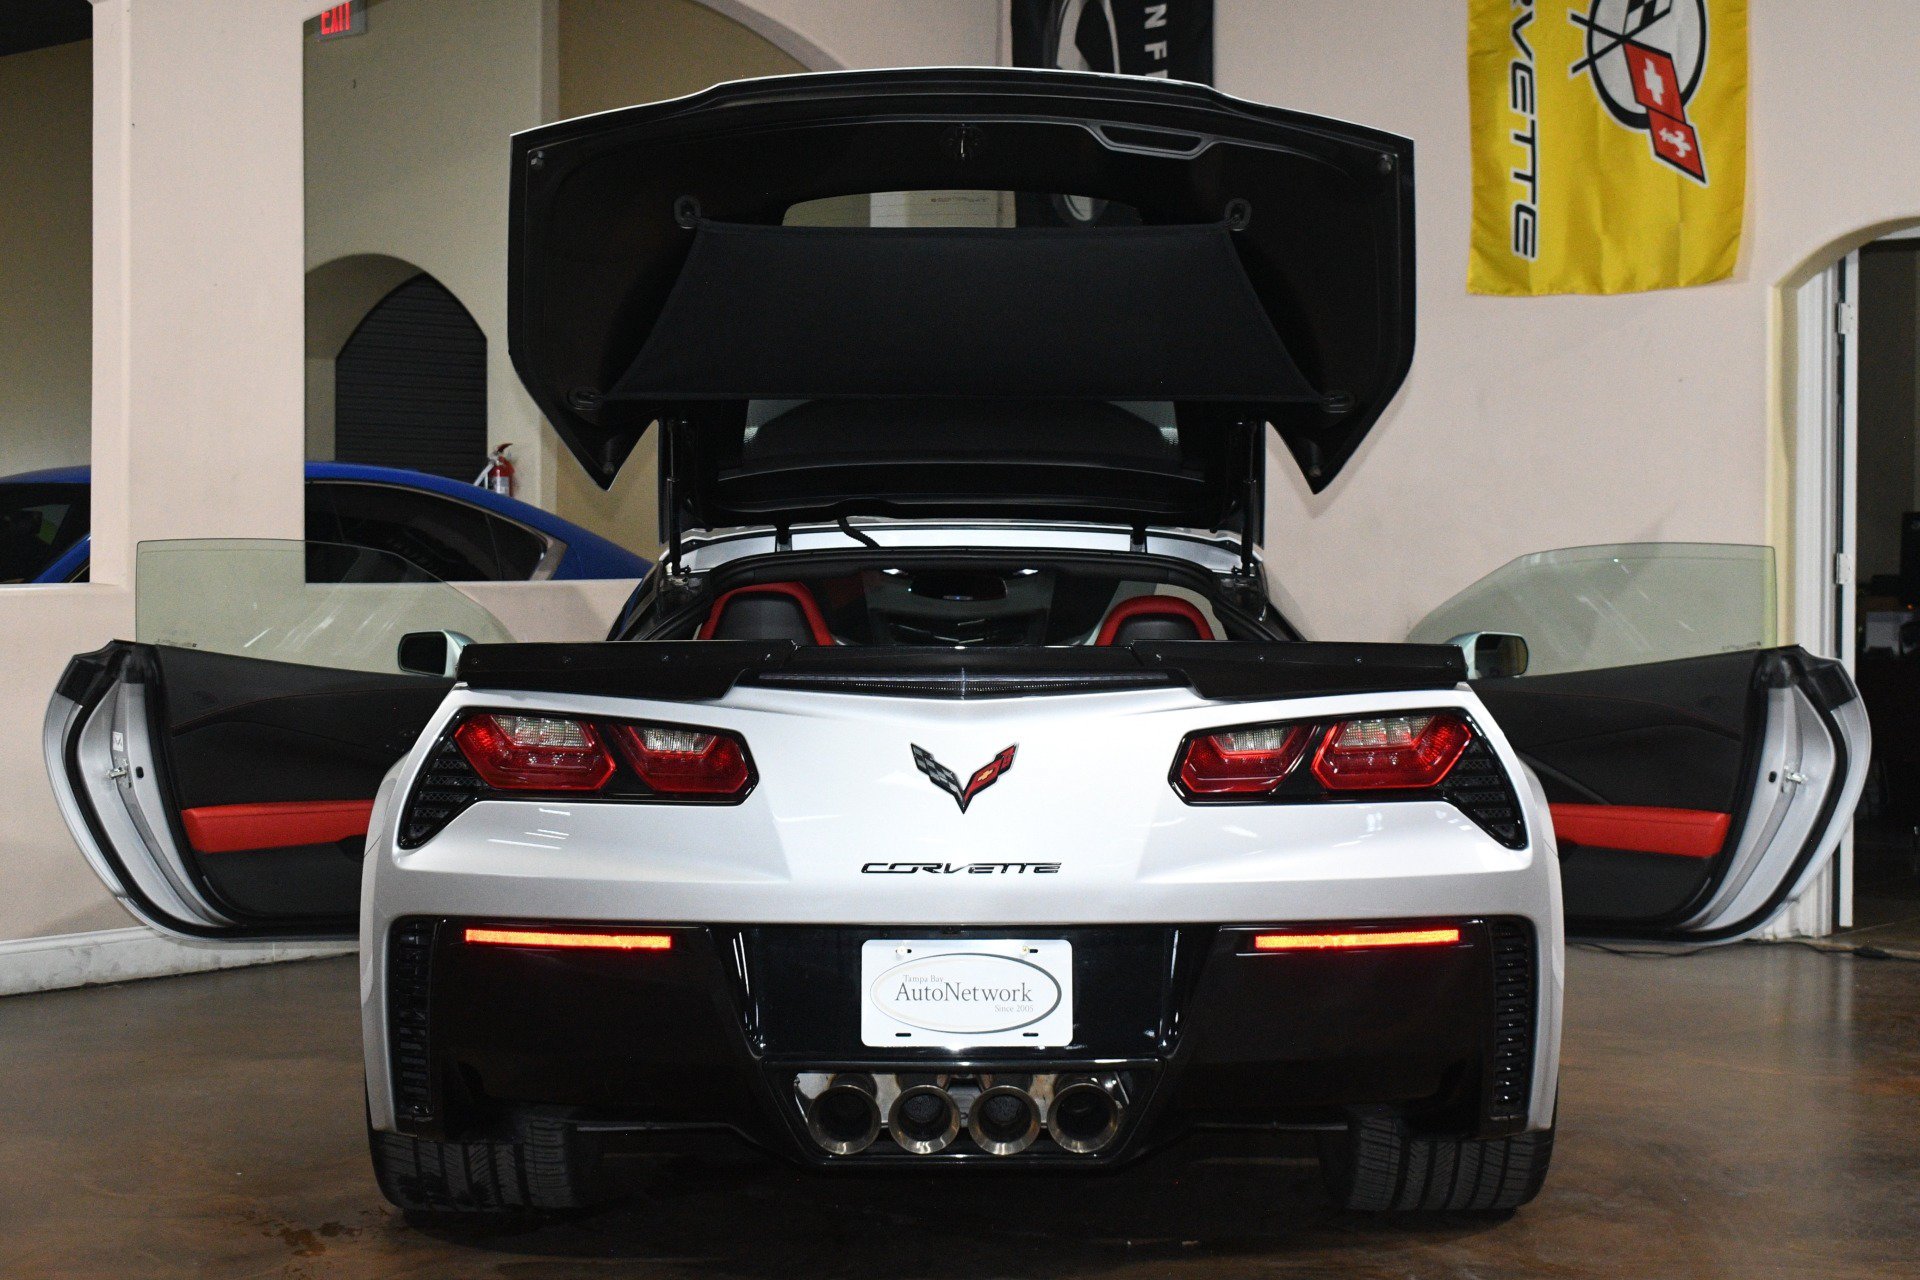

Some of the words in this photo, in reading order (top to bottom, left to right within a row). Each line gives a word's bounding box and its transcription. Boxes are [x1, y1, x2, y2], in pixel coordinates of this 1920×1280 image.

[1510, 0, 1537, 260] VETTE
[860, 862, 1062, 874] CORVETTE
[903, 974, 928, 984] Tampa
[930, 974, 944, 984] Bay
[895, 982, 1033, 1001] AutoNetwork
[994, 1004, 1014, 1012] Since
[1016, 1004, 1034, 1012] 2005
